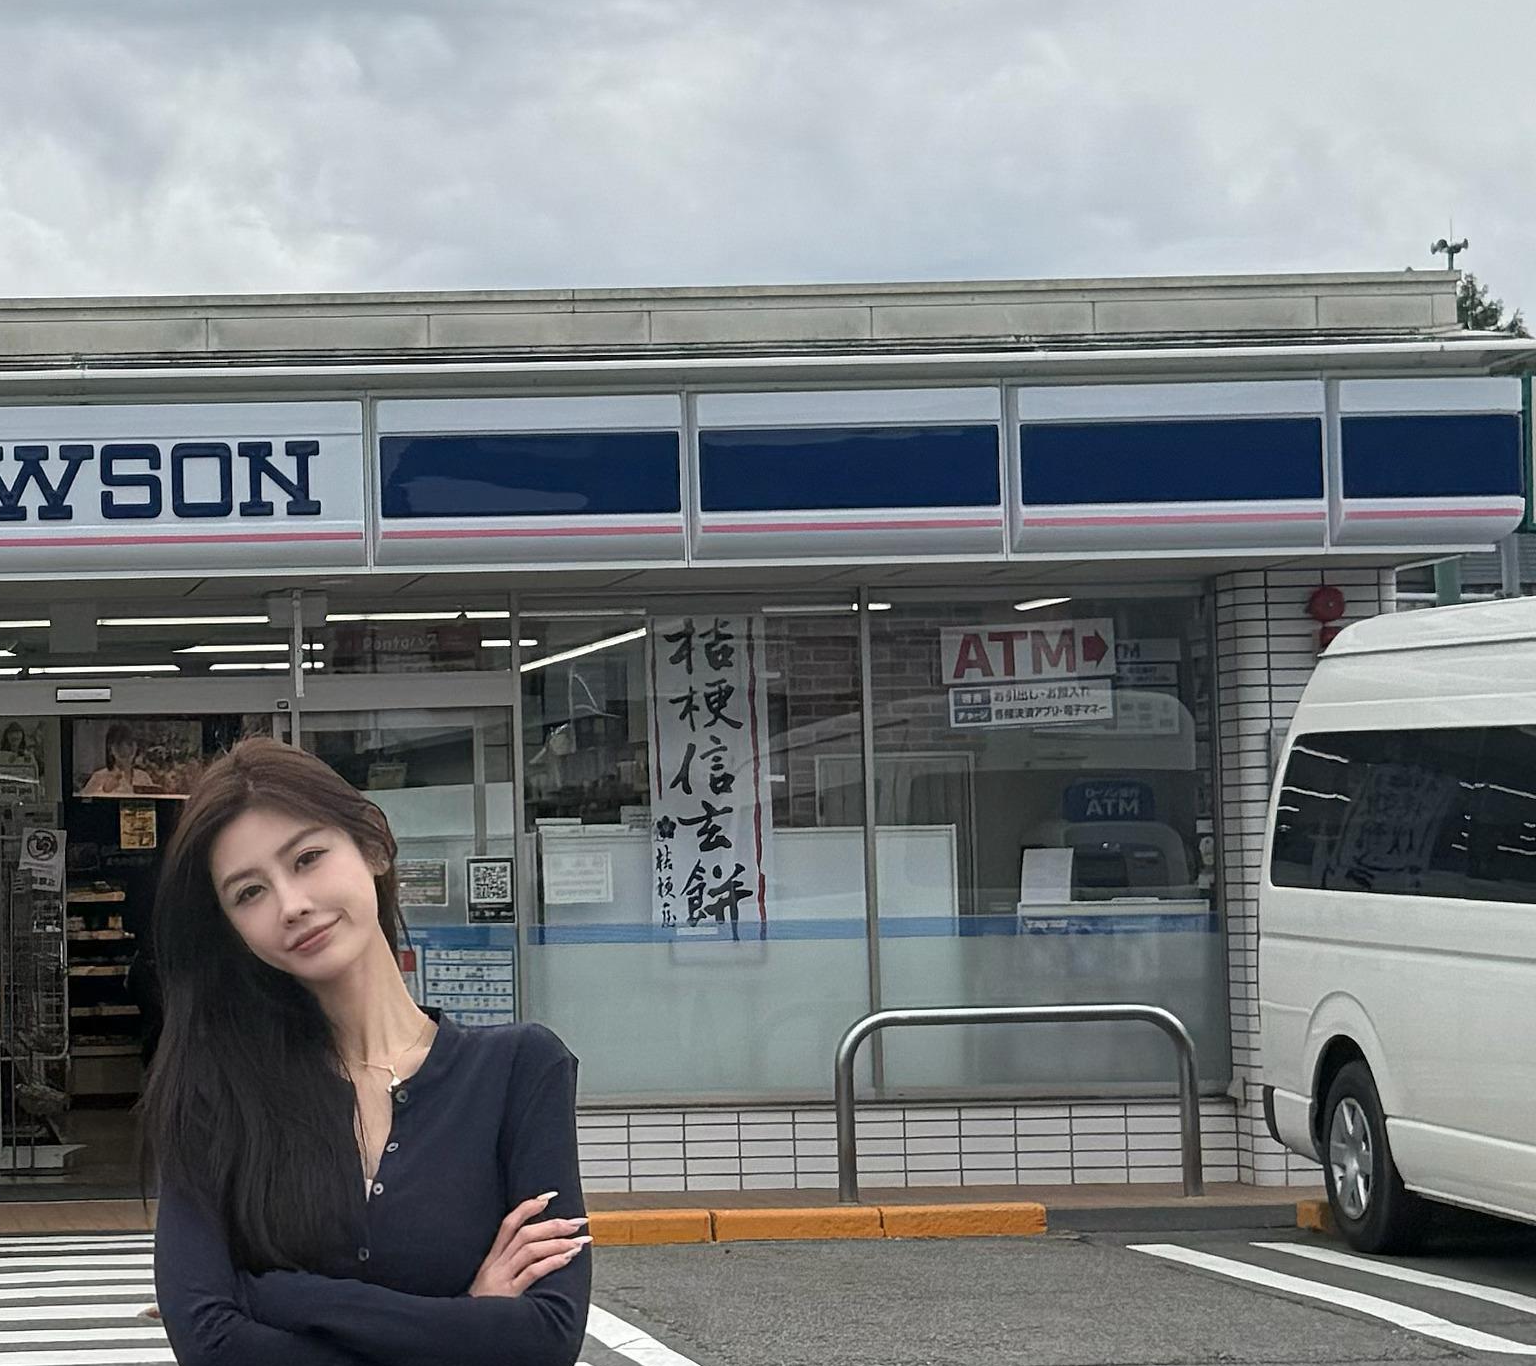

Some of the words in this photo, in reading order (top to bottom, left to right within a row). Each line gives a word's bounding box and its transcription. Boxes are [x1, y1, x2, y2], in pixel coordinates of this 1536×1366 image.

[952, 627, 1077, 679] ATM
[663, 616, 753, 941] 桔梗信玄餅
[1086, 798, 1139, 816] ATM
